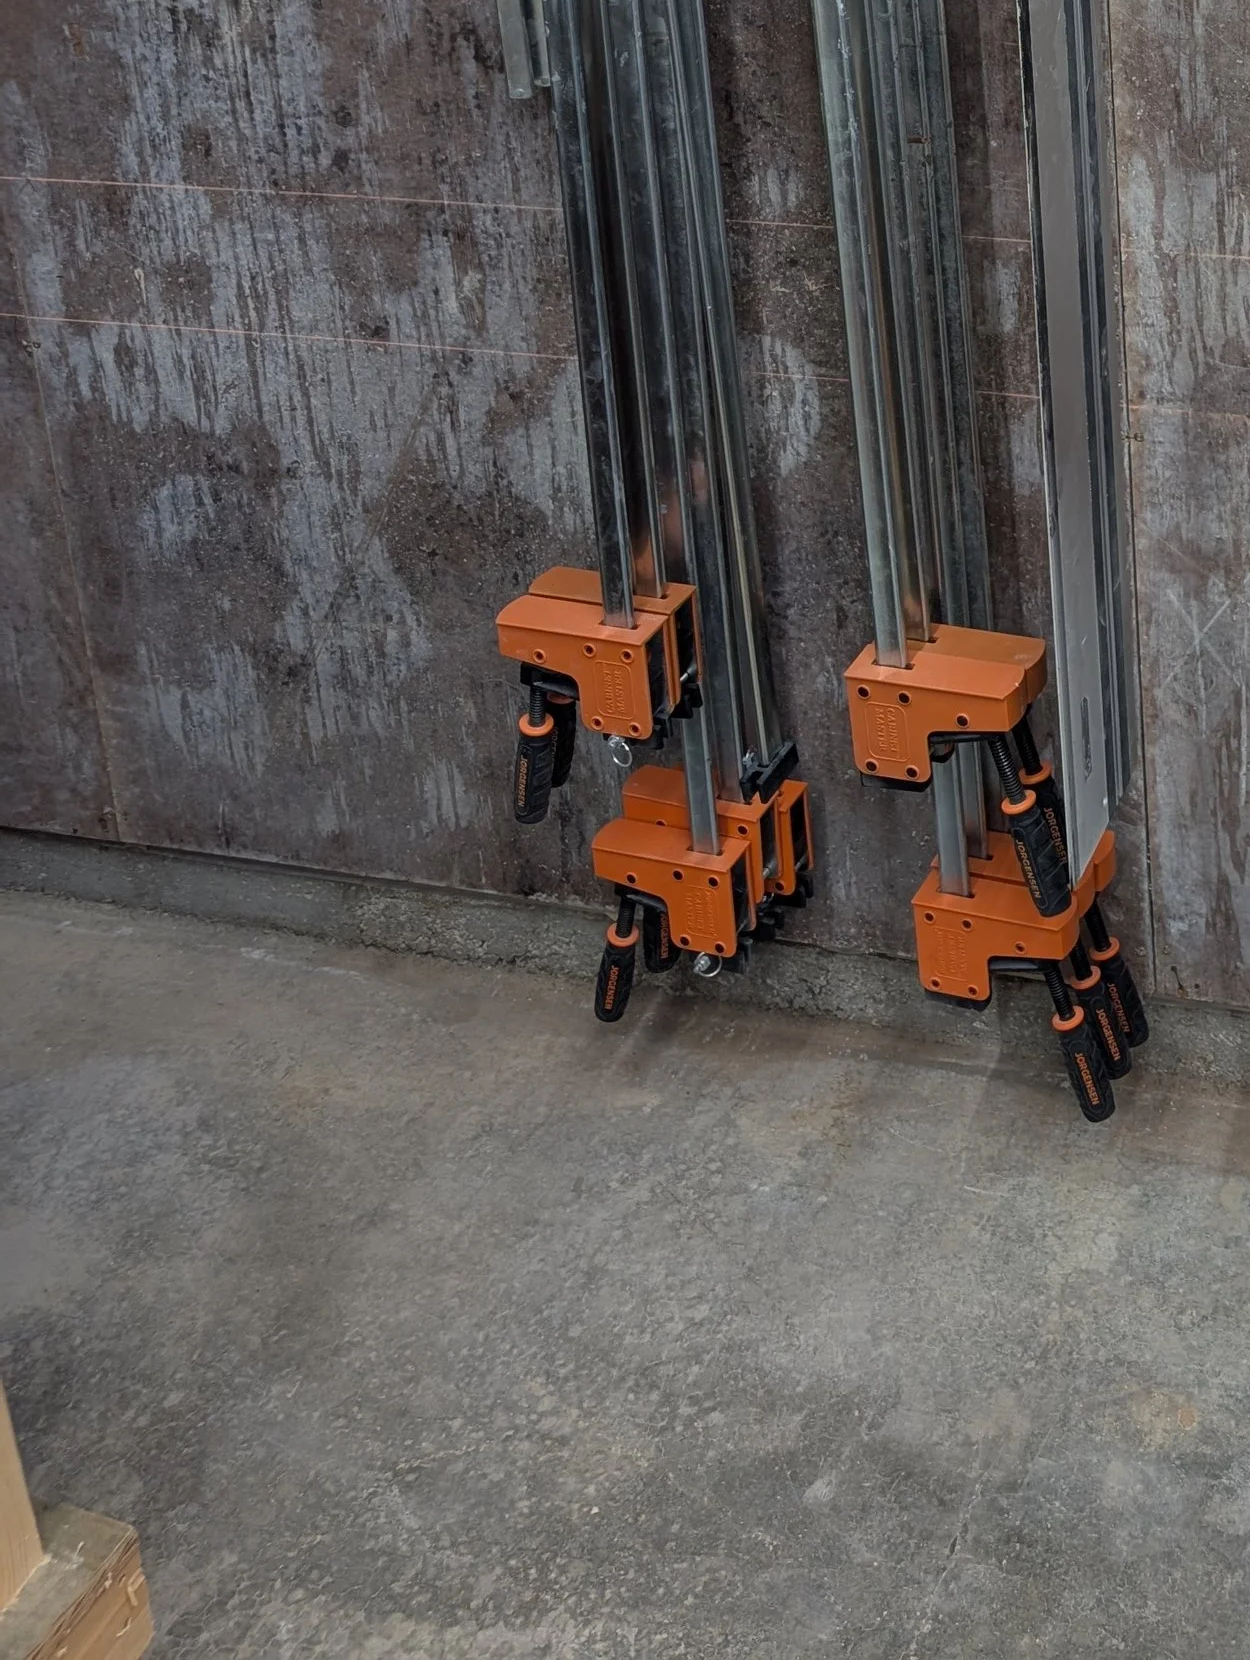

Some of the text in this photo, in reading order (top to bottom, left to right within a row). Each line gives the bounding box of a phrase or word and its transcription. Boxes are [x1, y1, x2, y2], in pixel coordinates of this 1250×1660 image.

[516, 756, 528, 808] JORGENSEN
[1043, 807, 1067, 865] JORGENSEN
[1016, 839, 1041, 899] JORGENSEN
[605, 965, 620, 1010] JORGENSEN
[1106, 982, 1131, 1033] JORGENSEN
[1095, 1008, 1121, 1061] JORGENSEN
[1074, 1052, 1100, 1105] JORGENSEN
